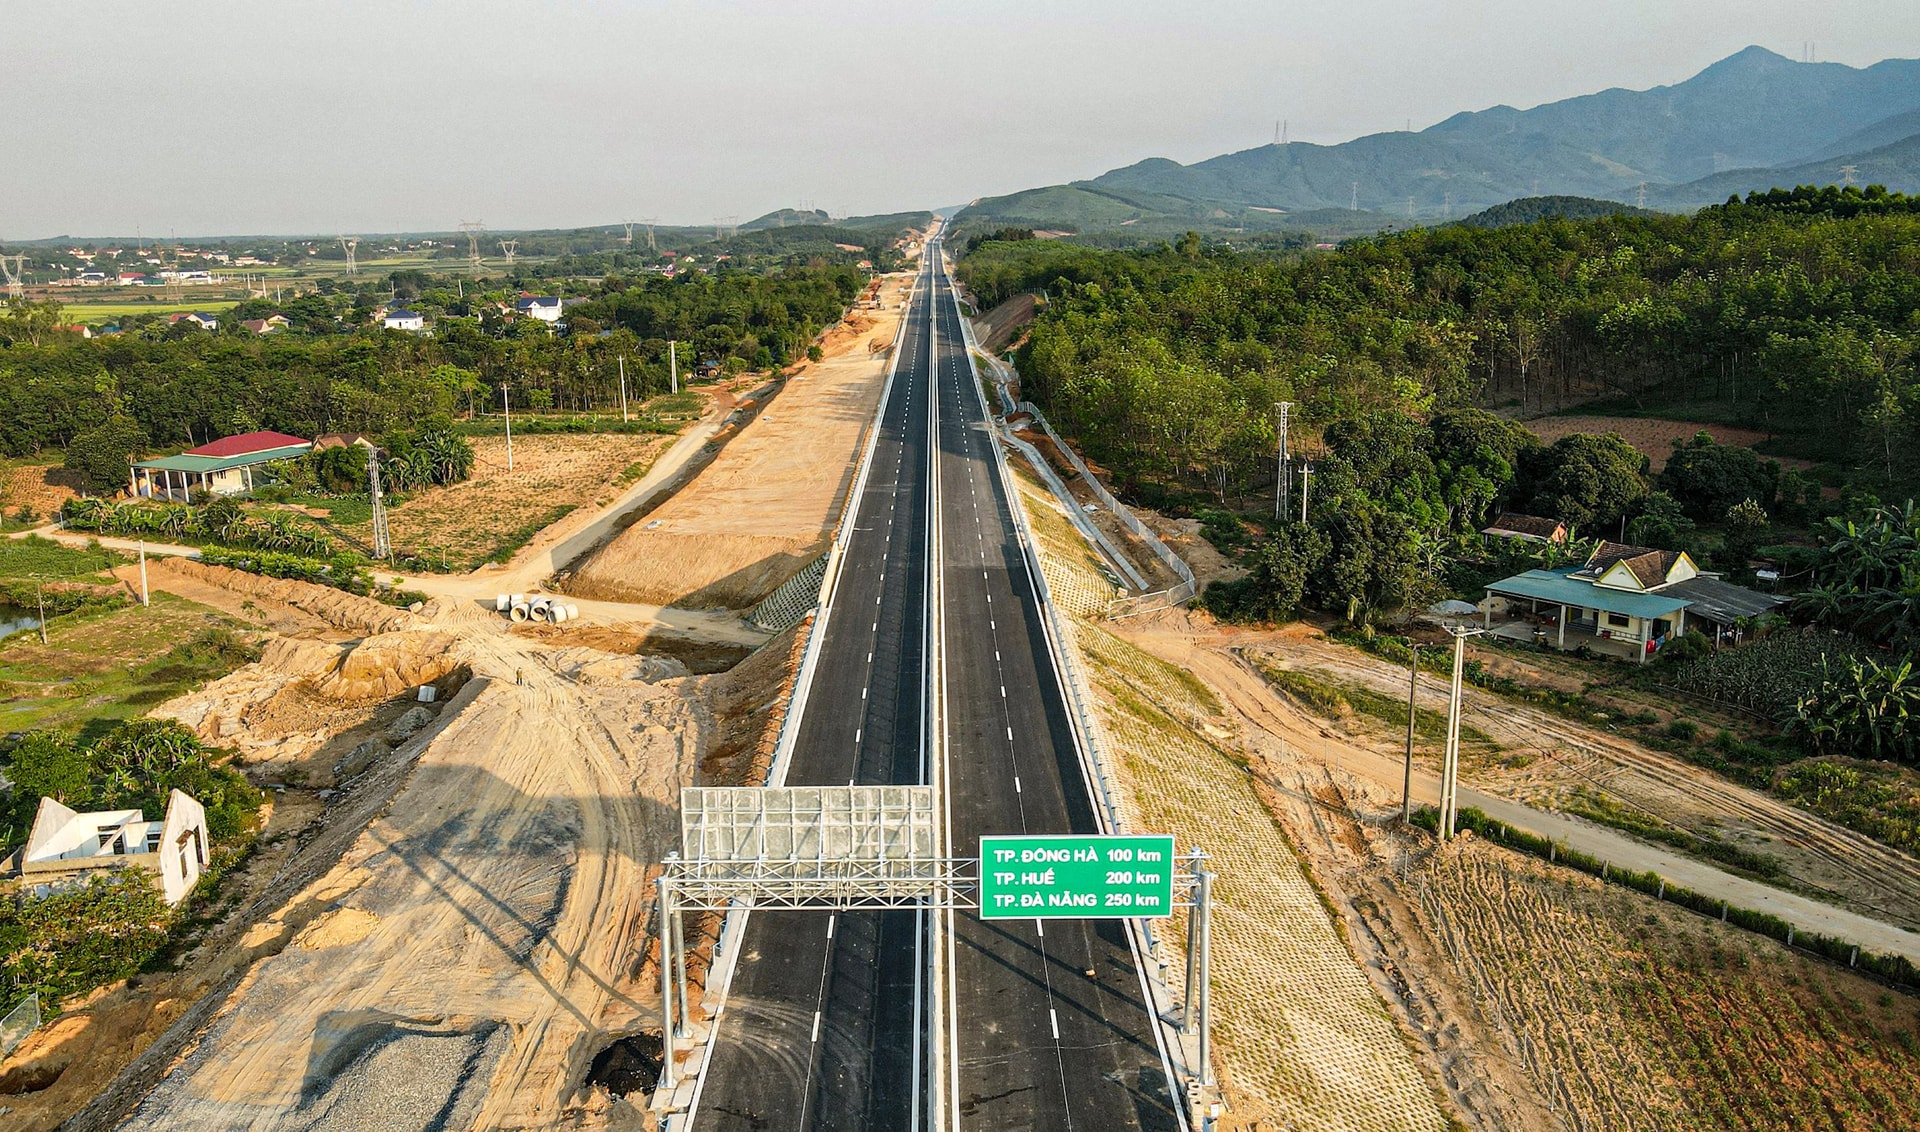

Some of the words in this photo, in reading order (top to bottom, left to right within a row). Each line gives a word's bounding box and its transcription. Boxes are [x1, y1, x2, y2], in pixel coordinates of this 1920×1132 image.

[1074, 846, 1098, 862] HÀ
[1107, 849, 1132, 861] 100
[1138, 849, 1161, 861] km
[1022, 867, 1055, 885] HUẾ
[1106, 872, 1132, 884] 200
[1136, 872, 1160, 884] km
[1020, 890, 1045, 906] ĐÀ
[1105, 894, 1132, 906] 250
[1136, 894, 1160, 906] km
